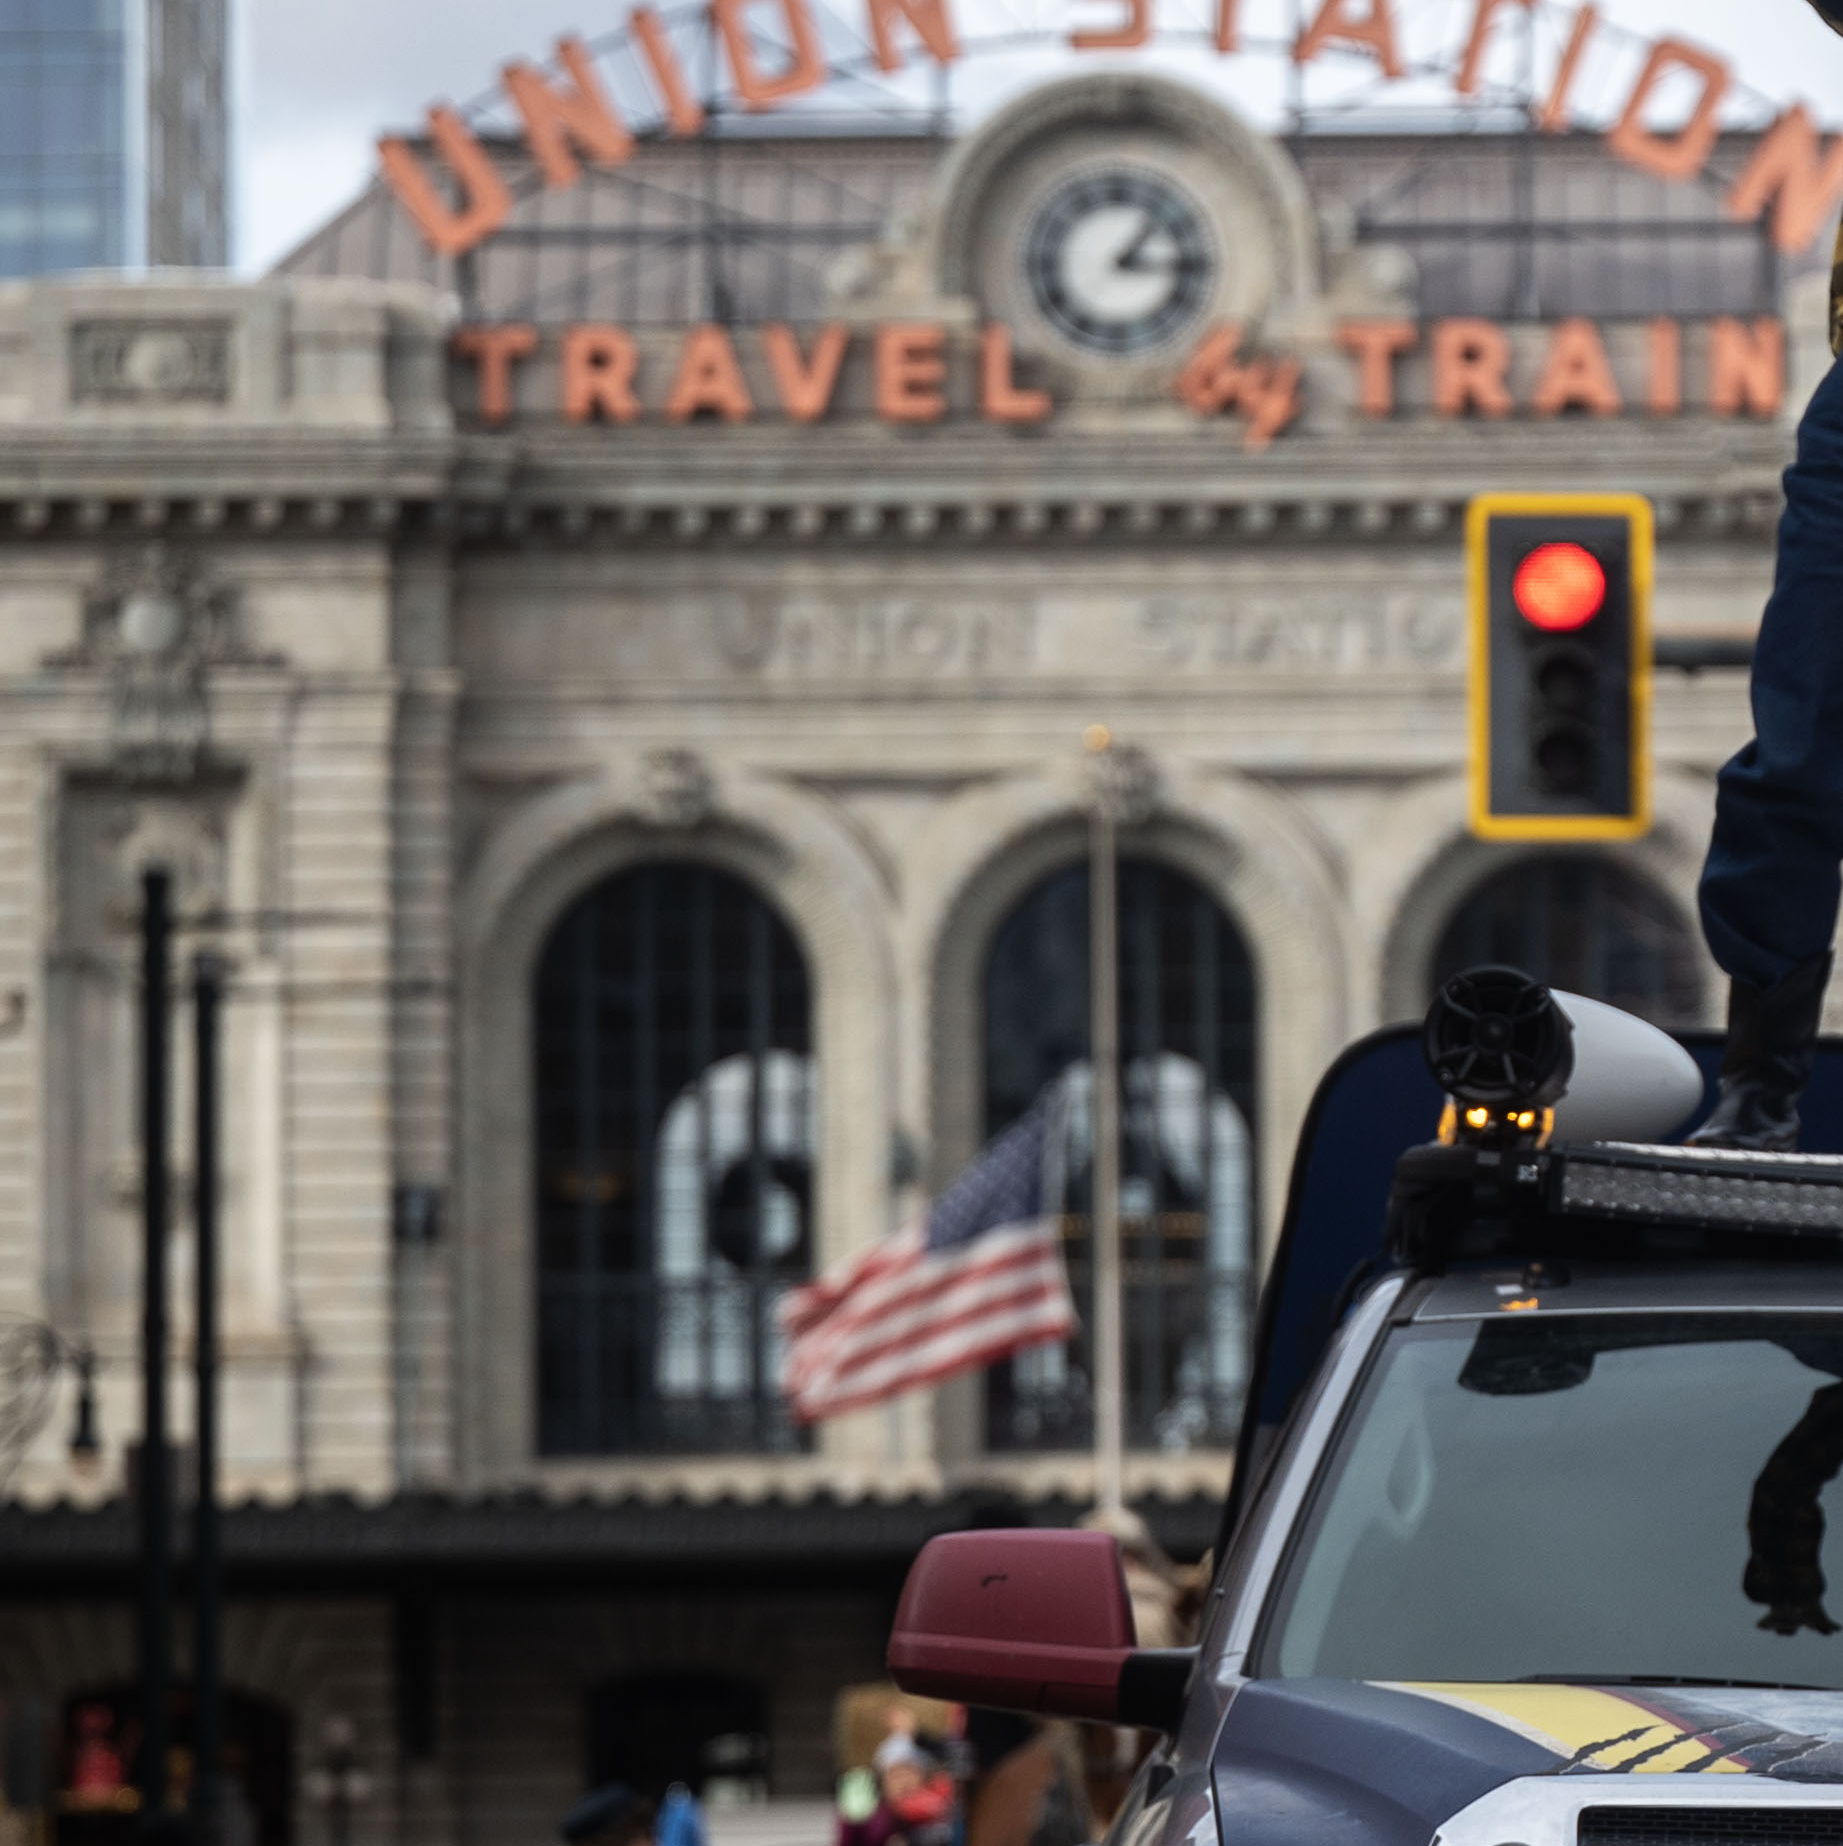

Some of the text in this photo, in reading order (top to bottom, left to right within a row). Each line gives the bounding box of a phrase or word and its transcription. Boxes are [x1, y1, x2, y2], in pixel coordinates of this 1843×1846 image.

[453, 315, 1786, 452] TRAVEL by TRAIN
